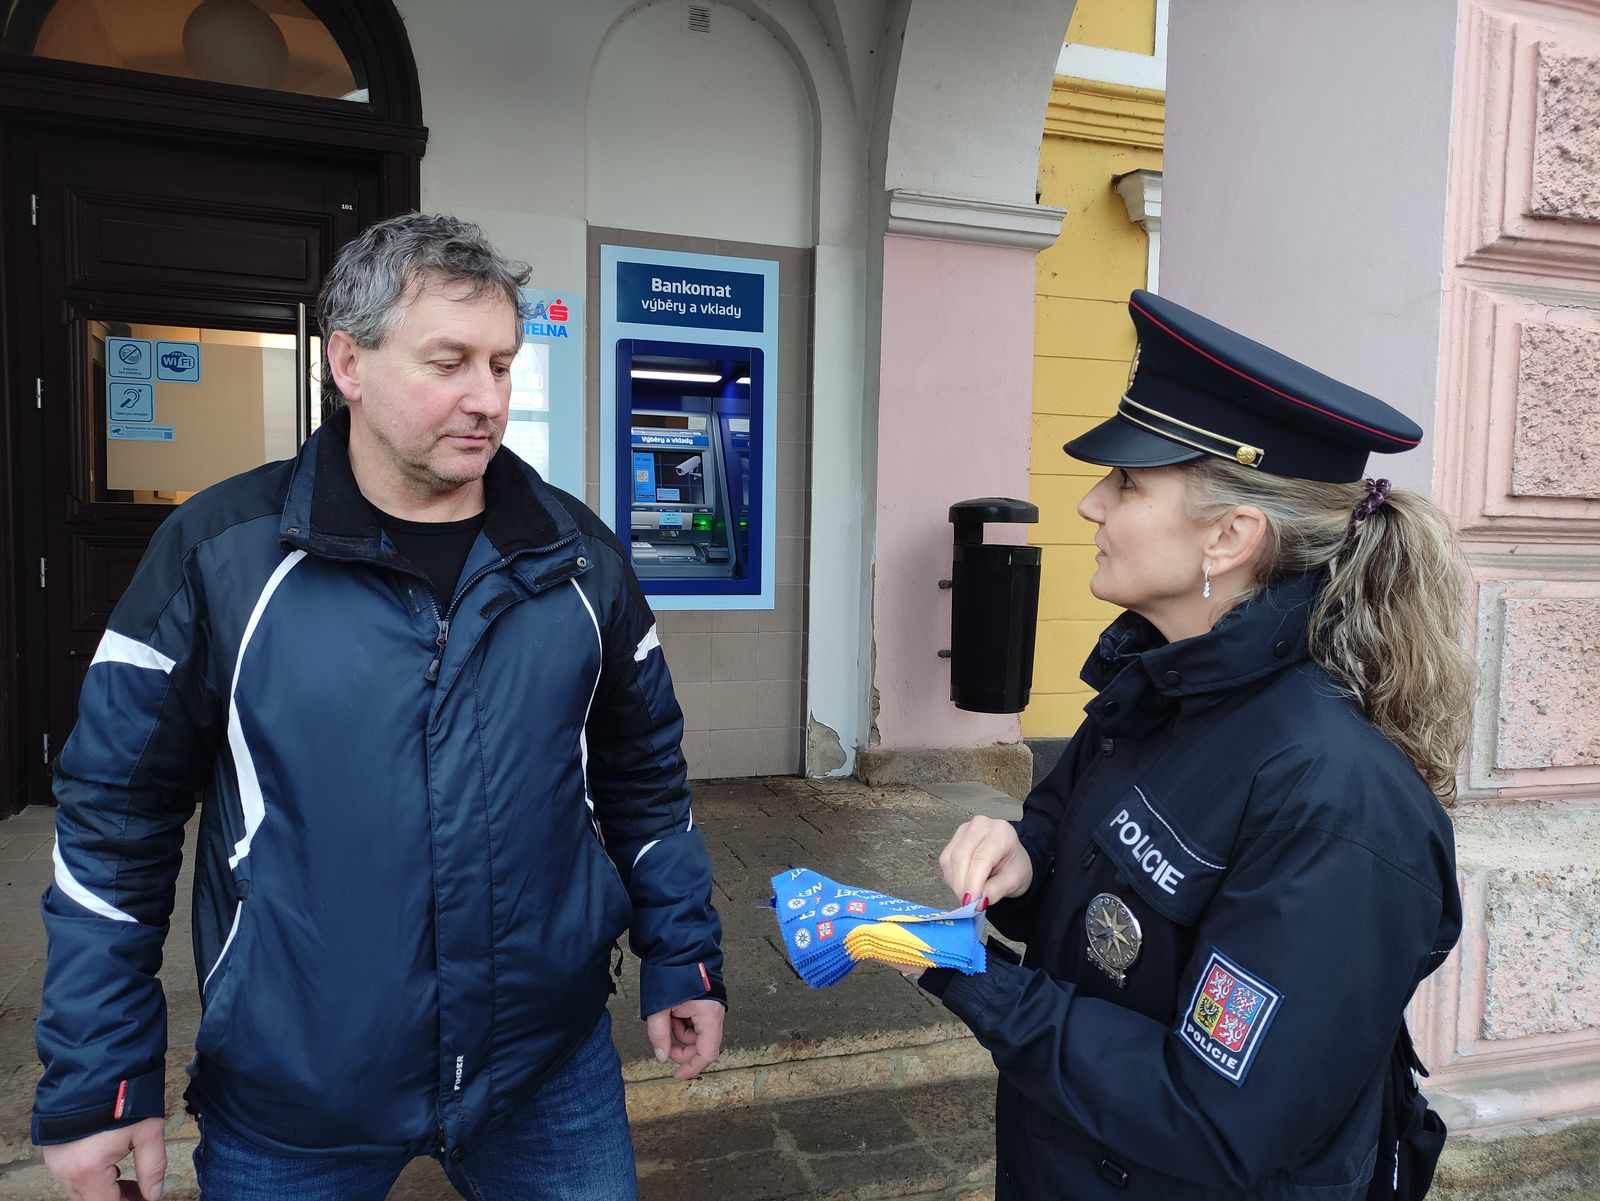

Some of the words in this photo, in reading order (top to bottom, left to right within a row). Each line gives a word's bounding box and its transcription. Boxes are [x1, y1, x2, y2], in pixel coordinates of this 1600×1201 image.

[651, 277, 732, 298] Bankomat
[641, 298, 686, 315] výběry
[689, 303, 697, 313] a
[700, 302, 741, 319] vklady
[522, 320, 568, 338] TELNA
[671, 436, 694, 446] vklady
[1109, 809, 1185, 895] POLICIE
[1187, 1023, 1239, 1070] POLICIE
